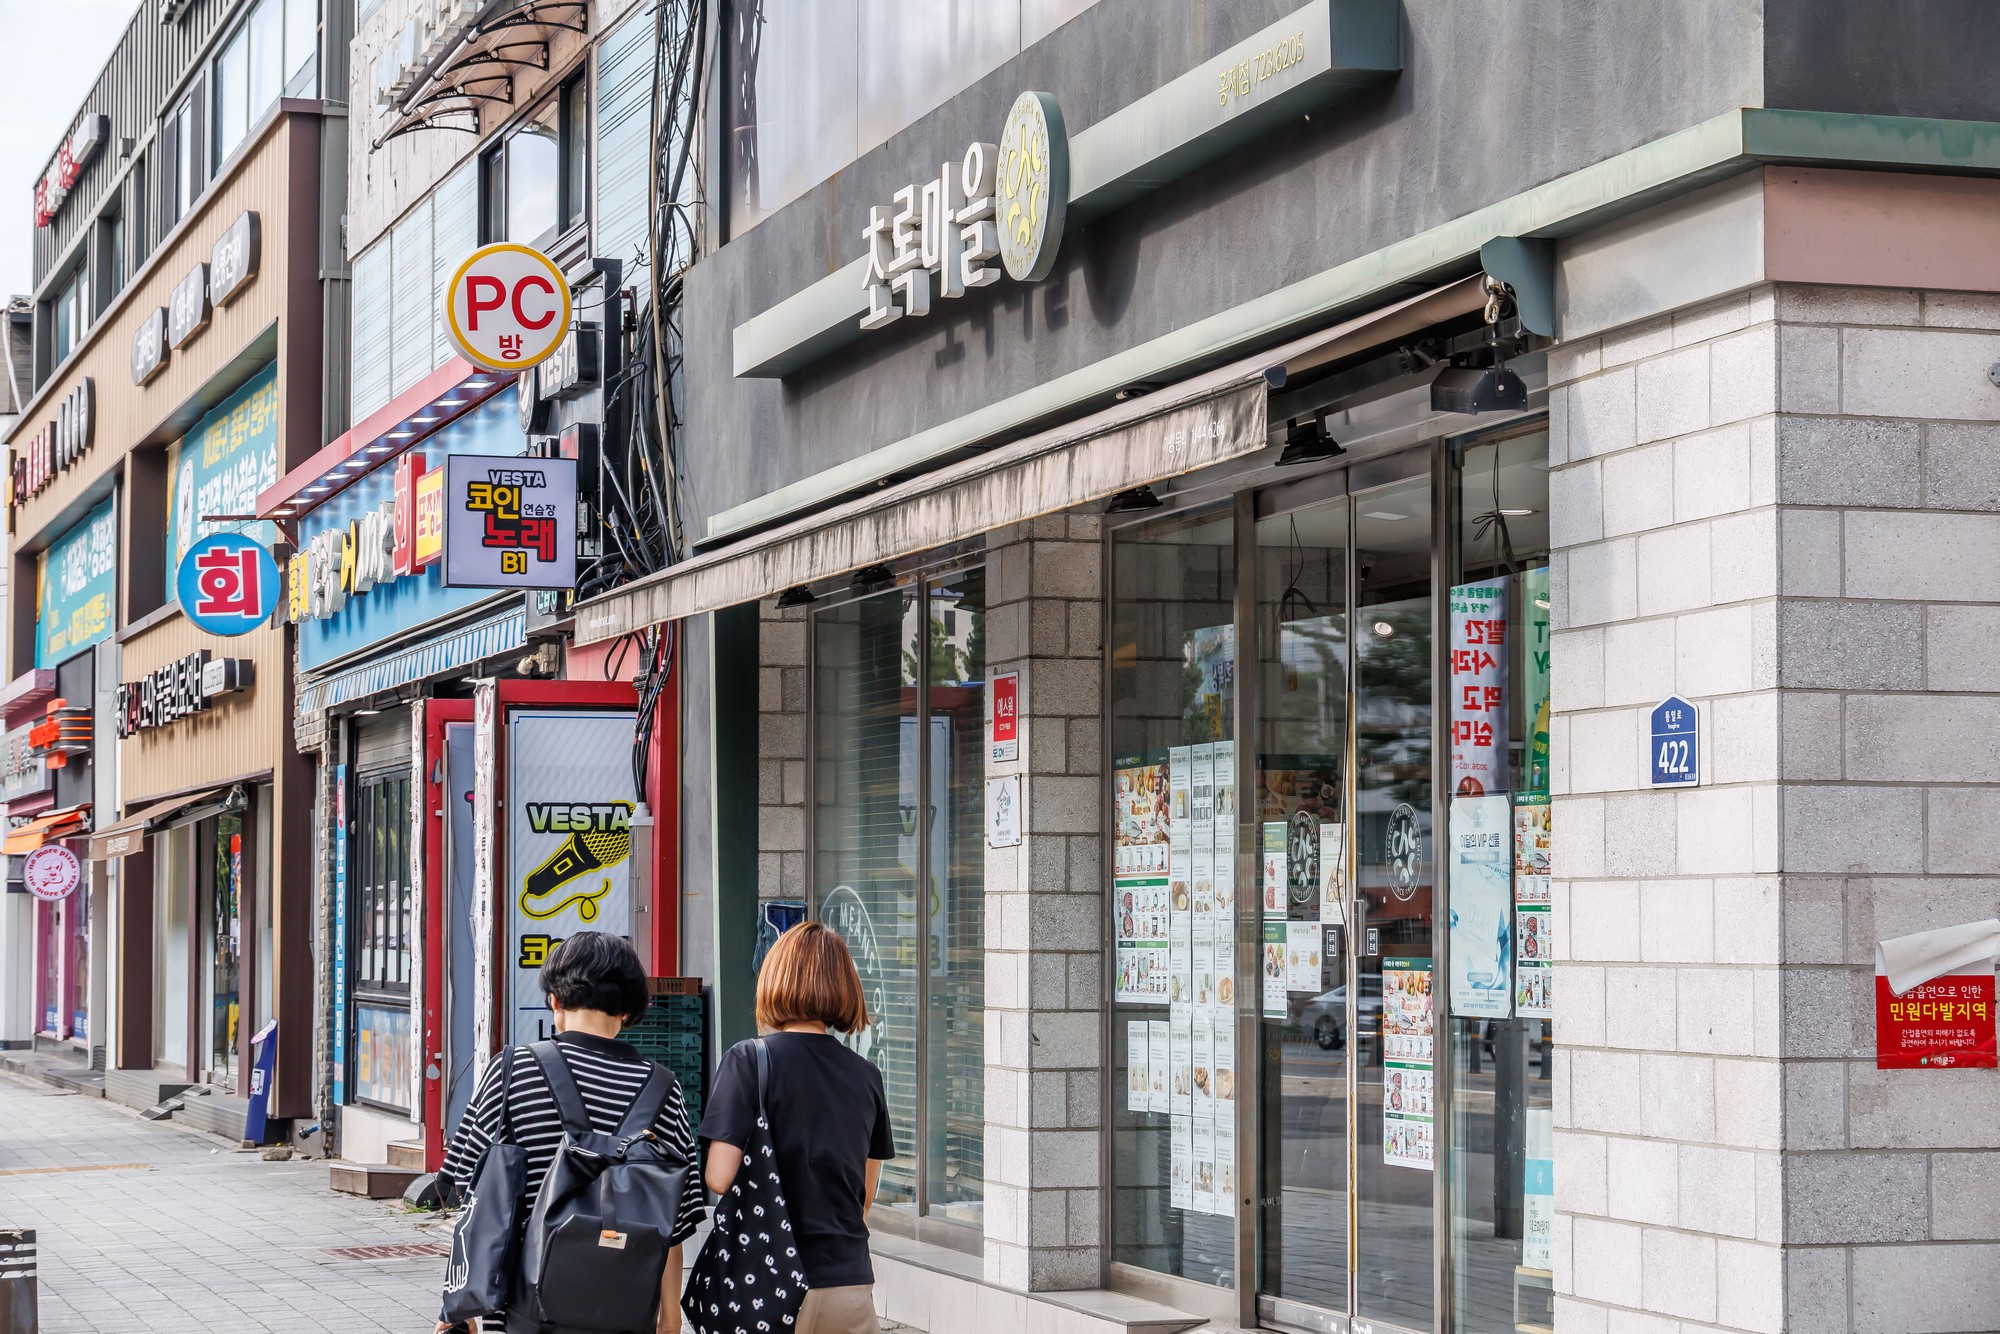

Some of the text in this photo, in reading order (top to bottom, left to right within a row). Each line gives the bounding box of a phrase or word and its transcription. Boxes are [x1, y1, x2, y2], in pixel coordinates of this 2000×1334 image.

[1218, 31, 1305, 106] 홍제점 723.6205
[860, 142, 998, 329] 초록마을
[466, 275, 556, 331] PC
[499, 334, 524, 360] 방
[540, 334, 578, 391] VESTA
[489, 470, 545, 487] VESTA
[467, 483, 556, 520] 코인 연습장
[393, 452, 412, 576] 회
[483, 515, 556, 561] 노래
[501, 551, 527, 575] B1
[199, 549, 259, 616] 회
[997, 696, 1014, 717] 에스원
[1664, 709, 1682, 723] 통일로
[1658, 739, 1689, 774] 422
[529, 803, 630, 831] VESTA
[1460, 833, 1500, 848] 이달의 VIP 선물
[35, 848, 58, 859] more
[59, 850, 77, 869] pizza
[35, 886, 58, 897] more
[60, 875, 77, 896] pizza
[1898, 985, 1982, 999] 습흡연으로 인한
[1890, 1002, 1987, 1022] 민원다발지역
[1900, 1039, 1977, 1047] 금연하여 주시기 바랍니다.
[1901, 1029, 1977, 1037] 간접흡연의 피해가 없도록
[1930, 1056, 1956, 1066] 서대문구
